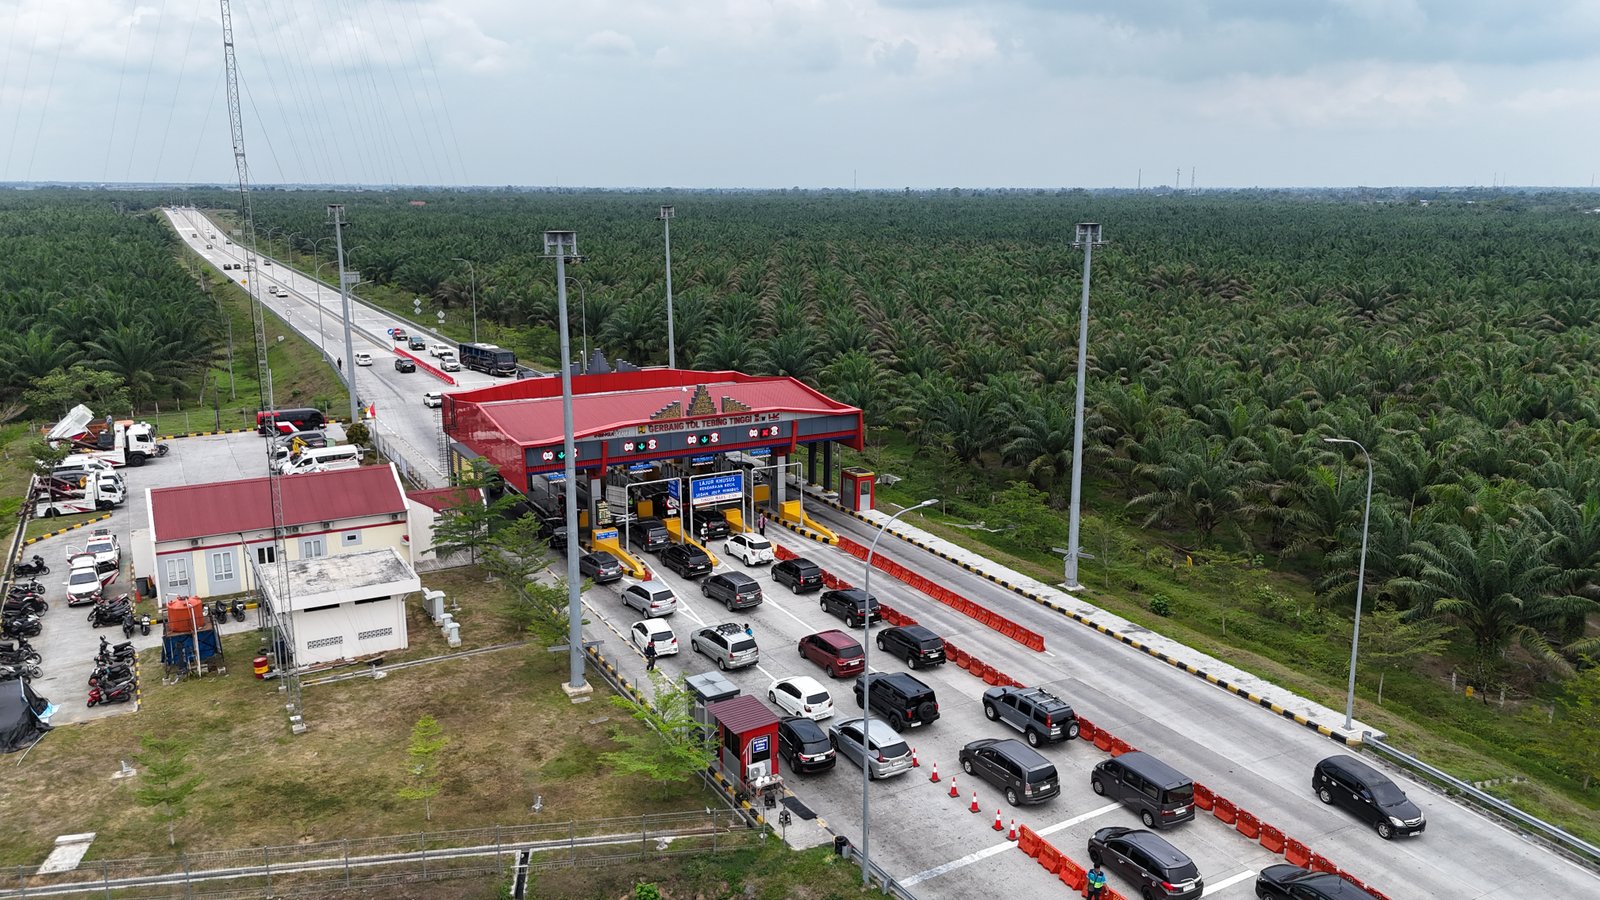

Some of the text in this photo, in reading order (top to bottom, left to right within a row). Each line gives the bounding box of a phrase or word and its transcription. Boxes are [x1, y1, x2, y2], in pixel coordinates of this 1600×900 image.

[648, 423, 684, 432] GERBANG
[686, 420, 700, 429] TOL
[702, 418, 727, 427] TEBING
[729, 416, 752, 424] TINGGI
